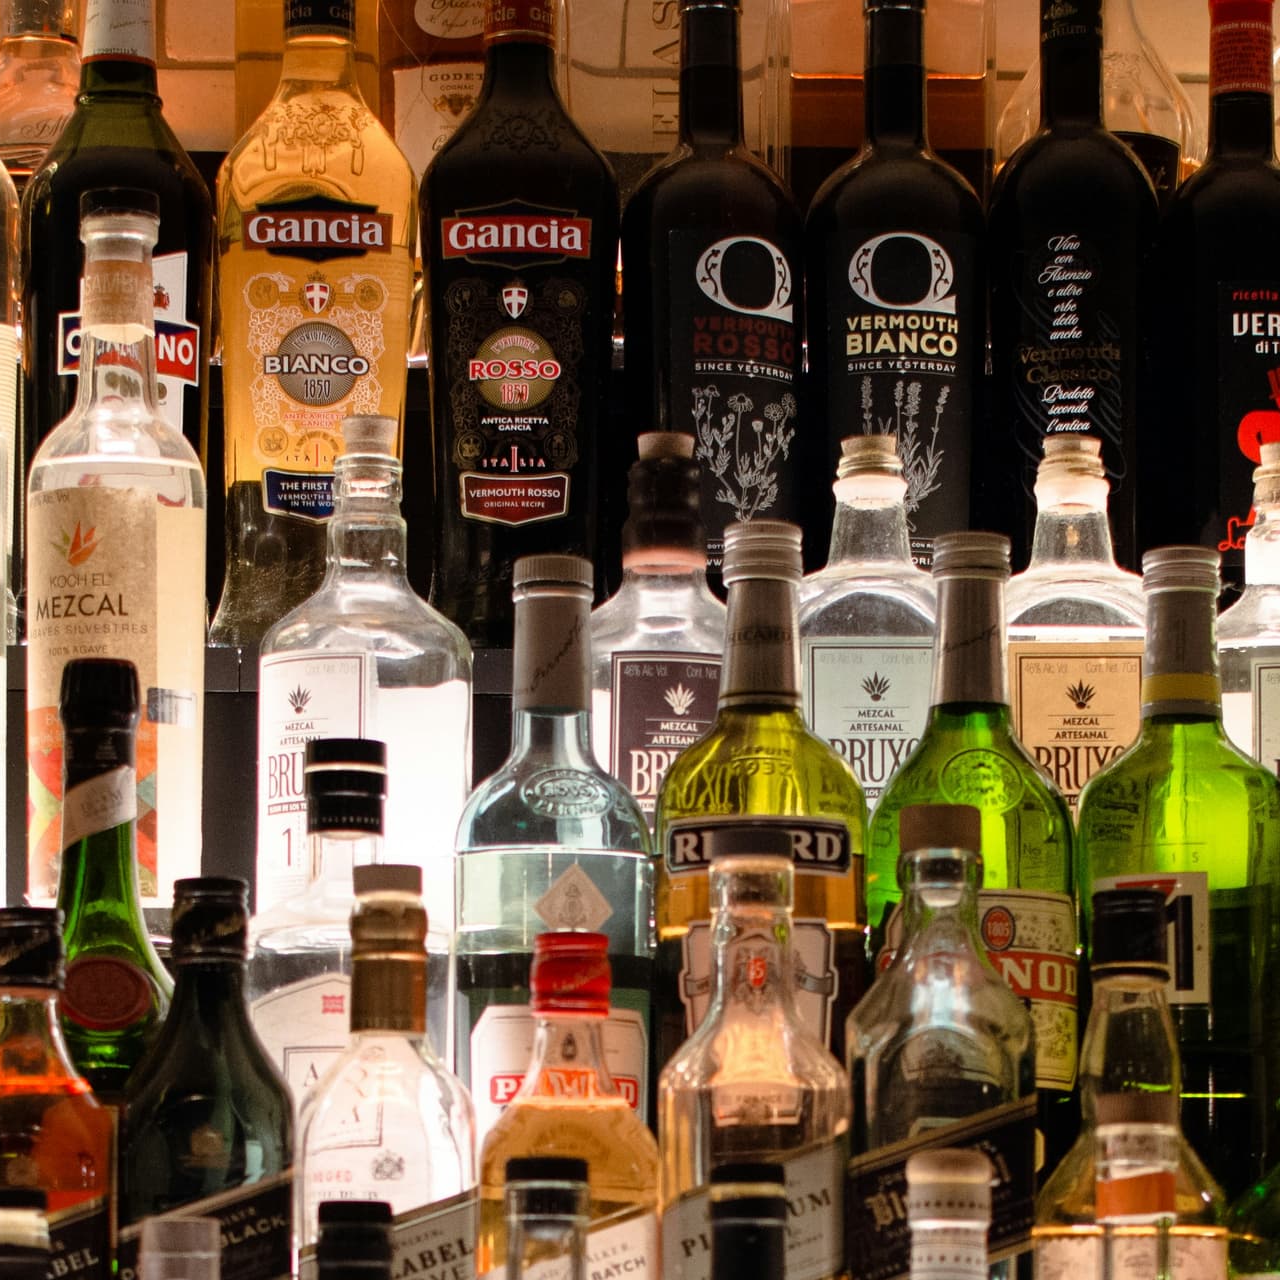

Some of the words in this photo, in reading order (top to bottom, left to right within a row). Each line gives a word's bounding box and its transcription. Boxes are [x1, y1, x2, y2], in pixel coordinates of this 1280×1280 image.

[249, 217, 384, 247] Gancia
[449, 220, 582, 251] Gancia
[1047, 235, 1079, 252] Vino
[1054, 254, 1074, 264] con
[1037, 266, 1092, 284] Assenzio
[1059, 285, 1082, 298] altre
[1233, 290, 1272, 303] ricetta
[1054, 301, 1076, 314] erbe
[847, 315, 958, 334] VERMOUTH
[1052, 314, 1079, 328] detto
[1050, 327, 1082, 340] anche
[692, 332, 795, 363] ROSSO
[847, 333, 958, 357] BIANCO
[1256, 341, 1268, 354] di
[265, 356, 368, 375] BIANCO
[469, 360, 562, 381] ROSSO
[695, 362, 732, 373] SINCE
[737, 363, 794, 381] YESTERDAY
[848, 361, 884, 372] SINCE
[888, 361, 956, 373] YESTERDAY
[1027, 363, 1113, 383] Classico
[304, 379, 330, 399] 1850
[1042, 384, 1095, 403] Prodotto
[1047, 402, 1088, 415] secondo
[513, 417, 549, 425] RICETTA
[498, 424, 532, 432] GANCIA
[280, 482, 297, 491] THE
[300, 482, 325, 492] FIRST
[469, 488, 524, 498] VERMOUTH
[527, 488, 561, 498] ROSSO
[50, 575, 88, 588] KOCH
[36, 593, 129, 621] MEZCAL
[65, 623, 149, 635] SILVESTRES
[73, 645, 107, 655] AGAVE
[858, 709, 895, 719] MEZCAL
[285, 721, 314, 730] MEZCAL
[660, 722, 697, 731] MEZCAL
[850, 723, 903, 732] ARTESANAL
[1063, 717, 1099, 726] MEZCAL
[1055, 730, 1108, 740] ARTESANAL
